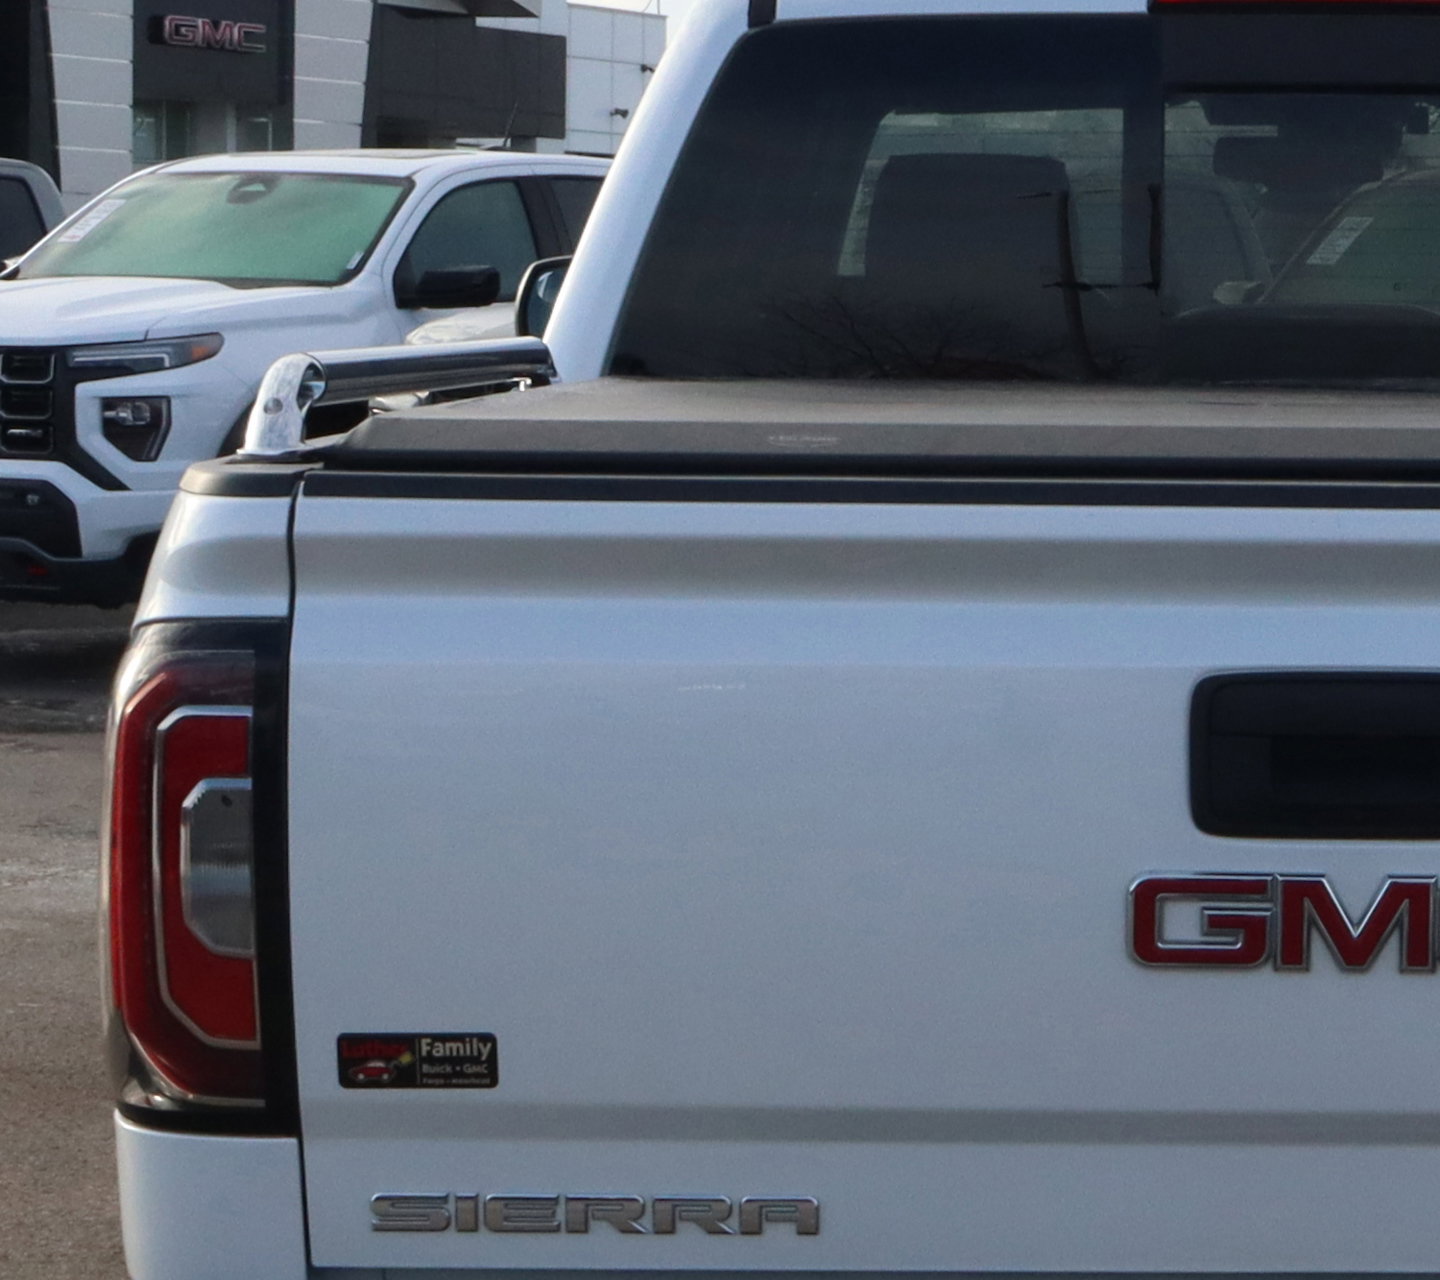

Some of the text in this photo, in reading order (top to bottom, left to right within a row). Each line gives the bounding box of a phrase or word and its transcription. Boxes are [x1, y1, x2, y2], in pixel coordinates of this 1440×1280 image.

[164, 15, 267, 53] GMC
[420, 1038, 492, 1061] Family
[370, 1191, 821, 1236] SIERRA
